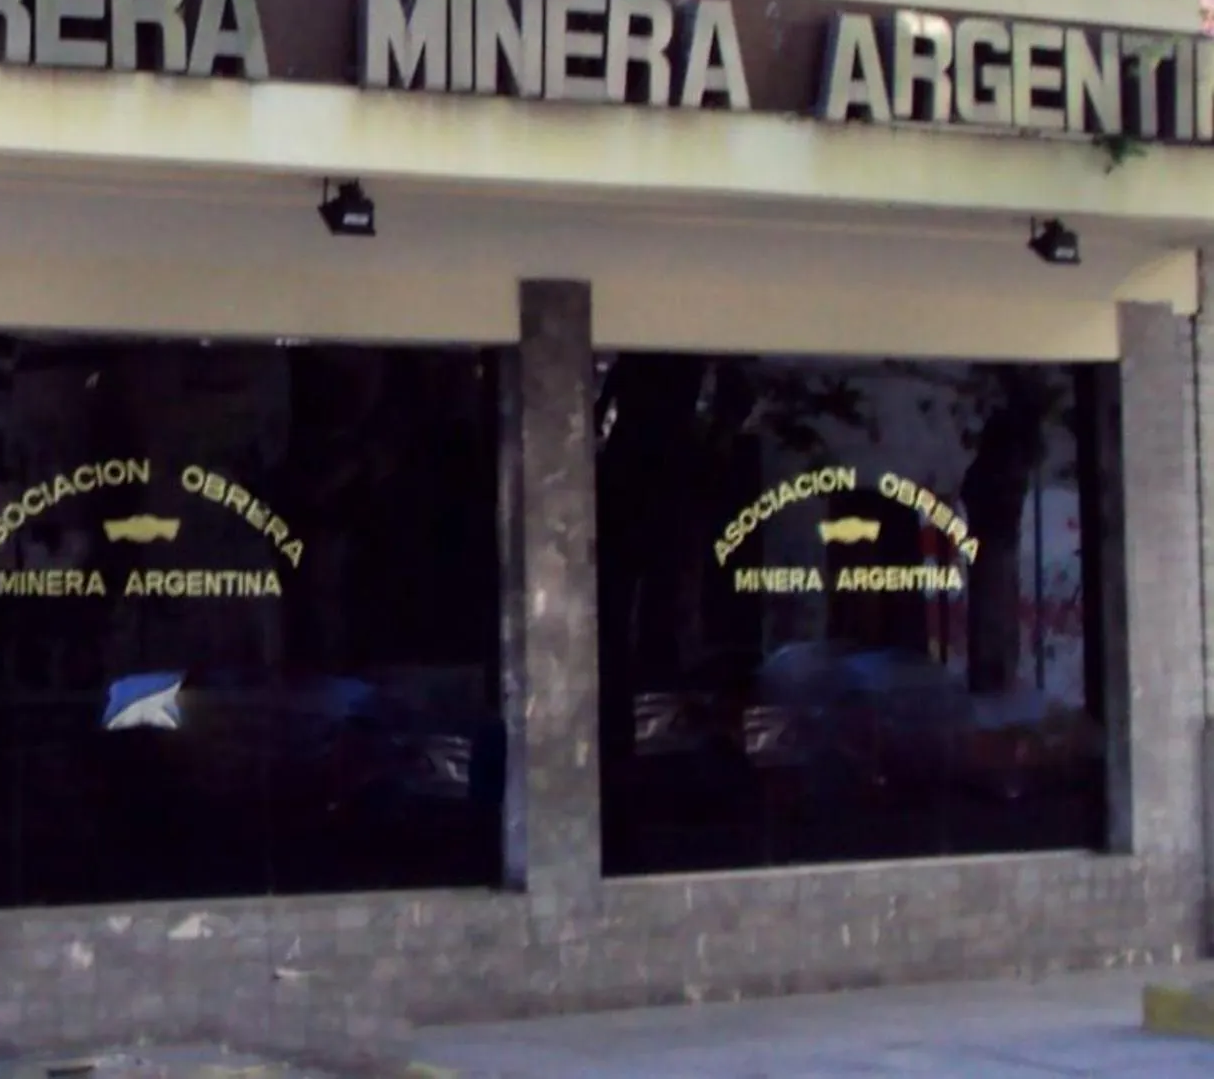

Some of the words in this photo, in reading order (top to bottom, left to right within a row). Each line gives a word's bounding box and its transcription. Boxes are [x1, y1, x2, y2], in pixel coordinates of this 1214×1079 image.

[181, 465, 304, 569] OBRERA
[714, 466, 857, 567] ASOCIACION
[878, 472, 980, 566] OBRERA
[124, 569, 282, 597] ARGENTINA
[735, 567, 824, 592] MINERA
[836, 566, 964, 592] ARGENTINA
